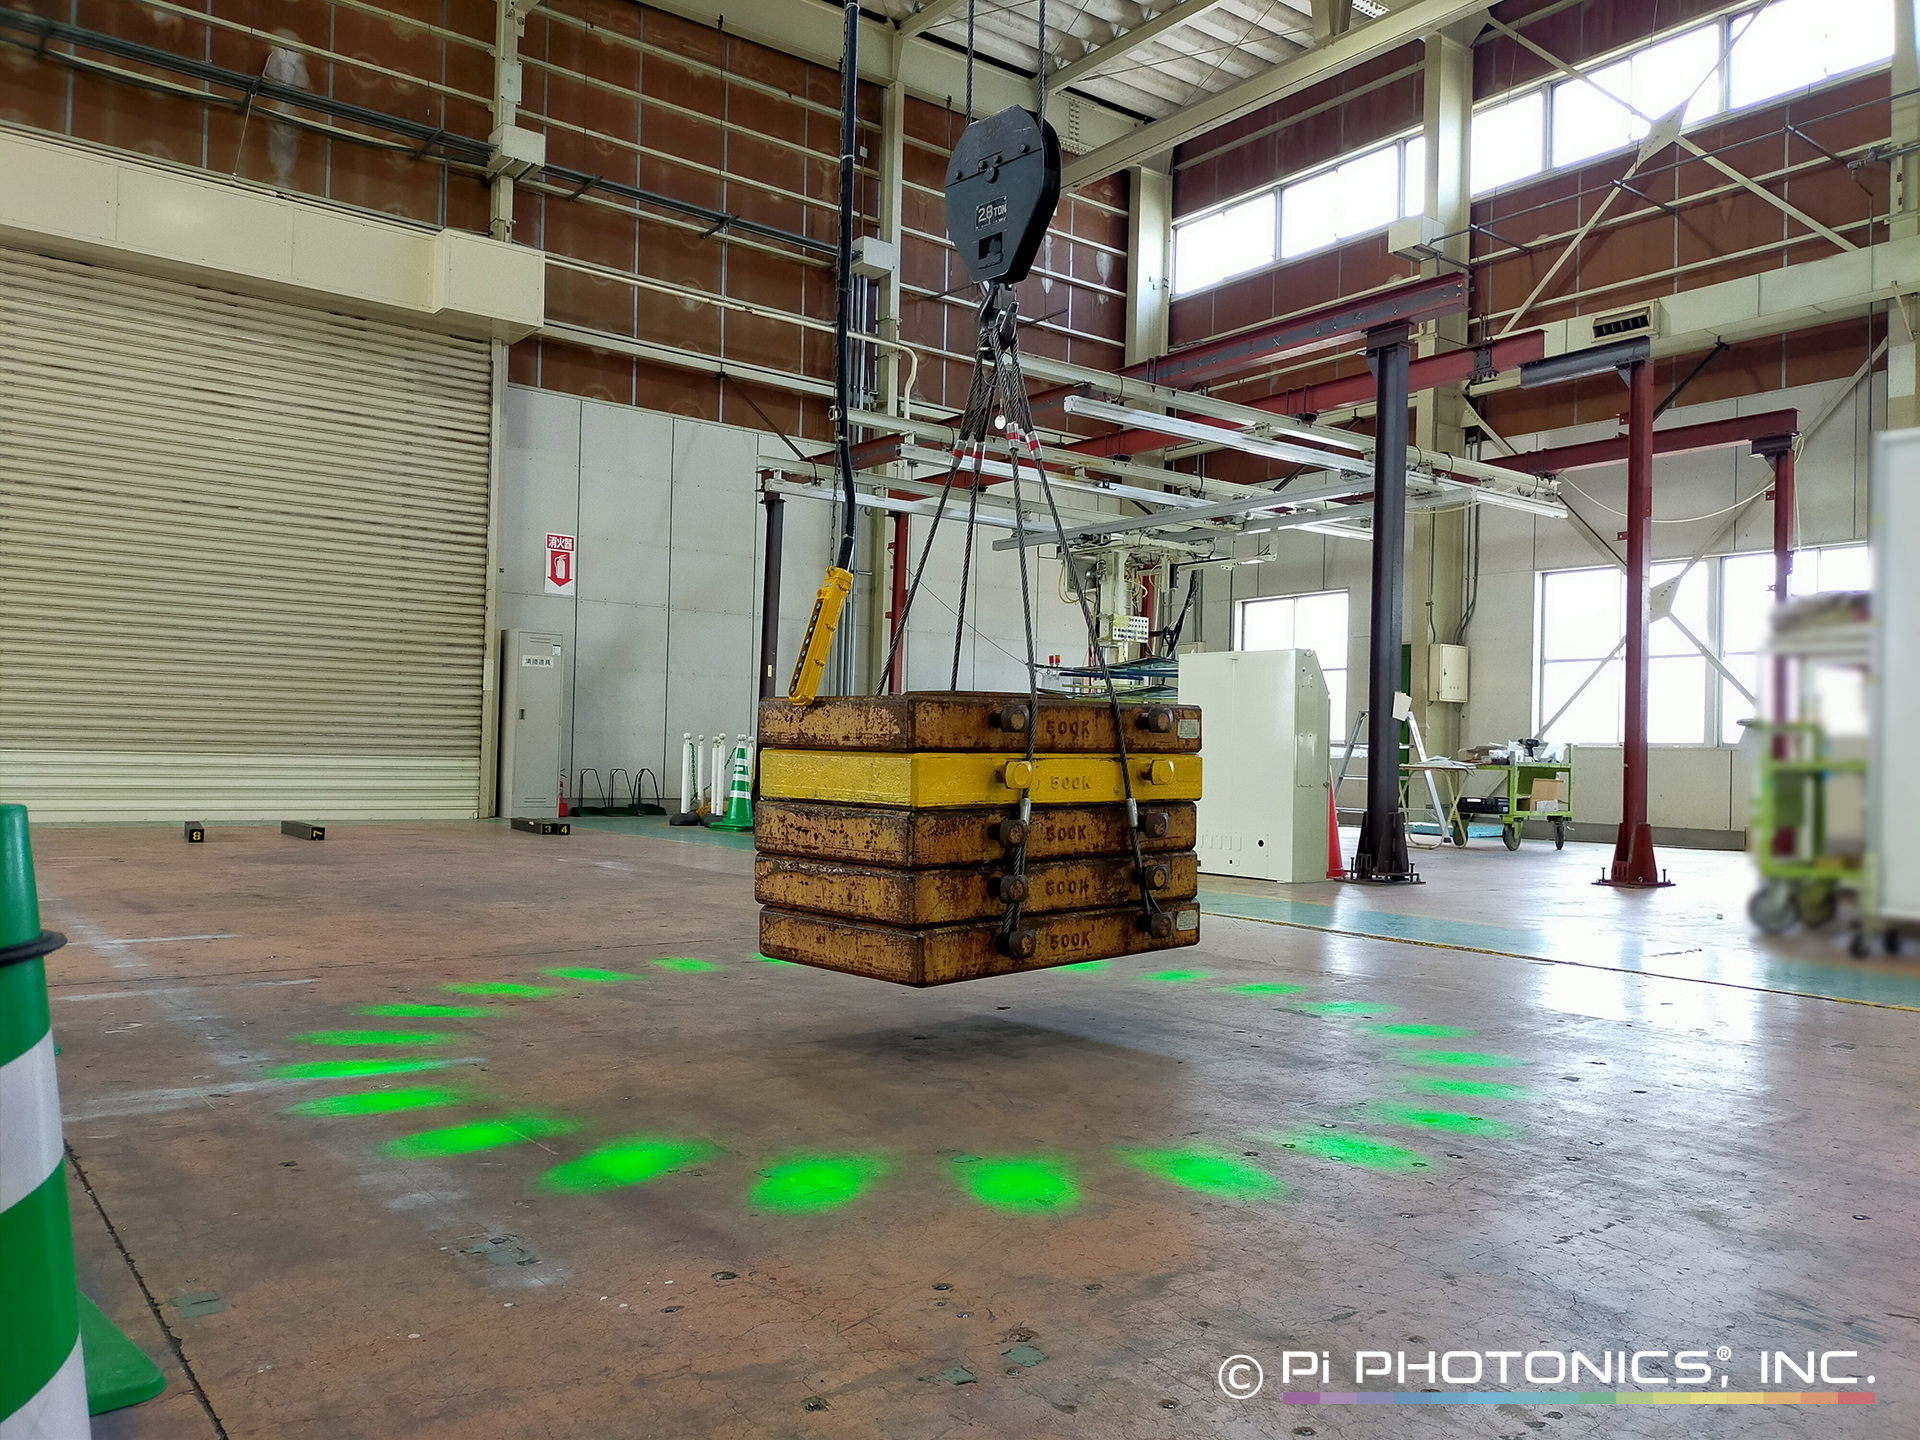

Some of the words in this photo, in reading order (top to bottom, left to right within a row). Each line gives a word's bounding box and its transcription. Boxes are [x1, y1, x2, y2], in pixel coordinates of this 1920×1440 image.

[978, 204, 993, 223] 28
[993, 203, 1007, 217] TON
[548, 535, 573, 550] 消火器
[1046, 720, 1090, 737] 500K
[192, 831, 202, 841] 8
[544, 825, 552, 834] 3
[560, 825, 568, 834] 4
[1046, 825, 1087, 842] 500K
[1051, 930, 1091, 950] 500K
